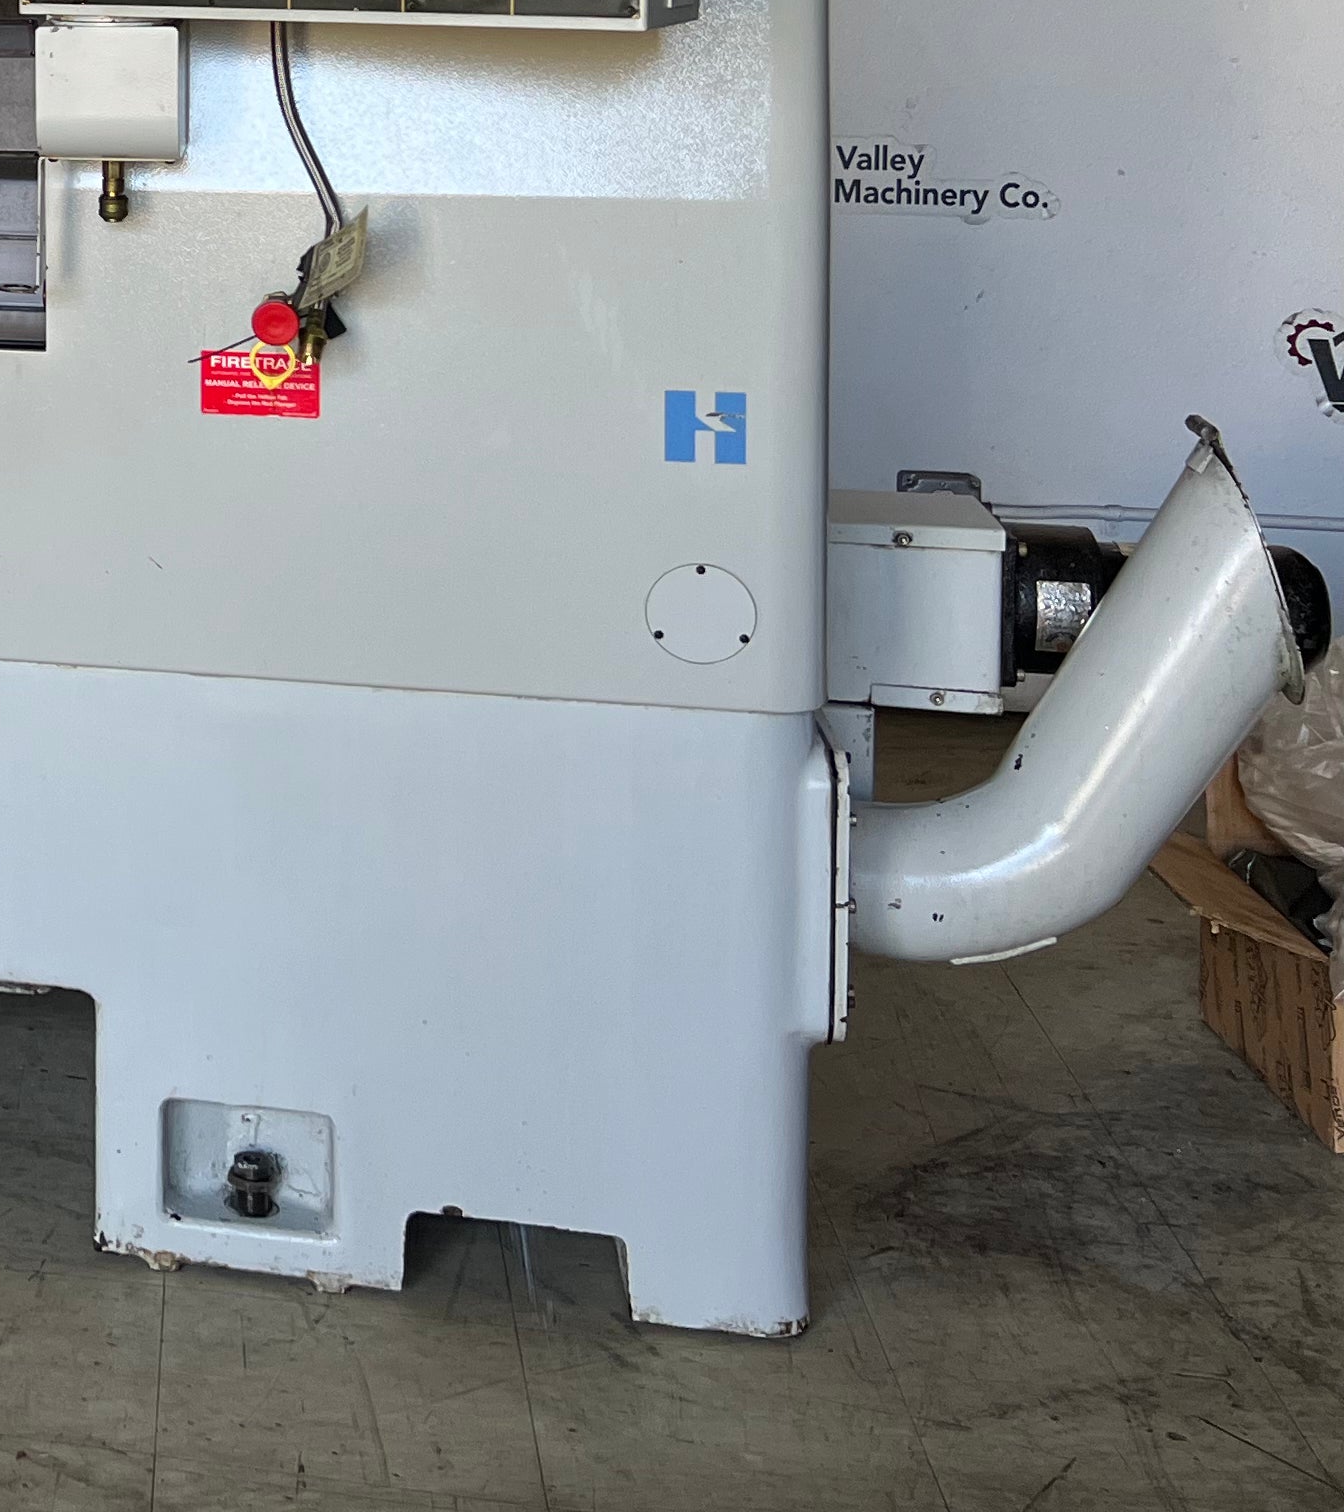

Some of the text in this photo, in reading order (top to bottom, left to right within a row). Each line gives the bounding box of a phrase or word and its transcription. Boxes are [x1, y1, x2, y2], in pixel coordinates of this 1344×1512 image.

[836, 144, 925, 179] Valley
[834, 178, 1048, 215] Machinery Co.
[205, 379, 241, 388] MANUAL
[283, 382, 316, 391] DEVICE
